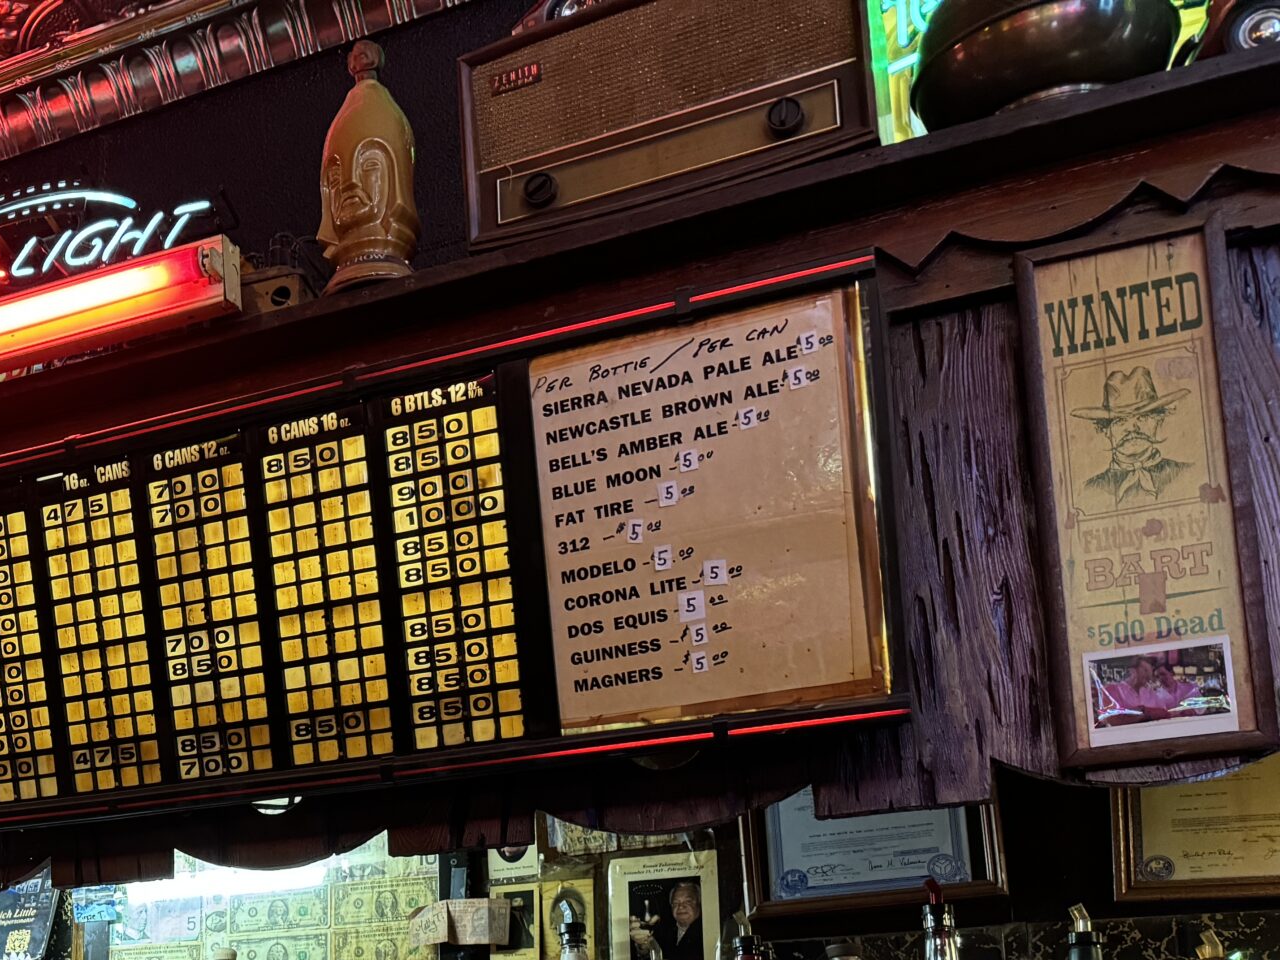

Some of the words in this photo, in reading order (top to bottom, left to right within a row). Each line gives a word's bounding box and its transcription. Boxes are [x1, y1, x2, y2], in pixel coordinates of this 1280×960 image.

[494, 64, 538, 88] ZENITH
[8, 201, 211, 278] LIGHT
[1044, 272, 1204, 358] WANTED
[530, 376, 571, 398] PER
[692, 335, 733, 358] PER
[746, 318, 789, 341] CAN
[542, 391, 609, 418] SIERRA
[618, 371, 693, 399] NEVADA
[703, 356, 752, 380] PALE
[761, 345, 799, 366] ALE
[405, 389, 447, 415] BTLS.
[449, 384, 466, 403] 12
[545, 404, 652, 445] NEWCASTLE
[662, 390, 733, 419] BROWN
[744, 380, 780, 403] ALE
[280, 417, 318, 442] CANS
[320, 413, 337, 434] 16
[164, 443, 200, 470] CANS
[549, 447, 608, 473] BELL'S
[617, 431, 683, 458] AMBER
[693, 421, 729, 441] ALE
[552, 479, 597, 500] BLUE
[606, 465, 662, 489] MOON
[555, 509, 585, 527] FAT
[594, 500, 634, 520] TIRE
[558, 536, 590, 555] 312
[561, 557, 636, 584] MODELO
[1084, 543, 1213, 591] BART
[564, 586, 639, 611] CORONA
[649, 576, 687, 596] LITE
[567, 620, 603, 639] DOS
[614, 609, 668, 632] EQUIS
[1086, 615, 1145, 646] $500
[1155, 609, 1225, 640] Dead
[570, 638, 661, 666] GUINNESS
[573, 666, 663, 693] MAGNERS
[14, 908, 36, 918] Little
